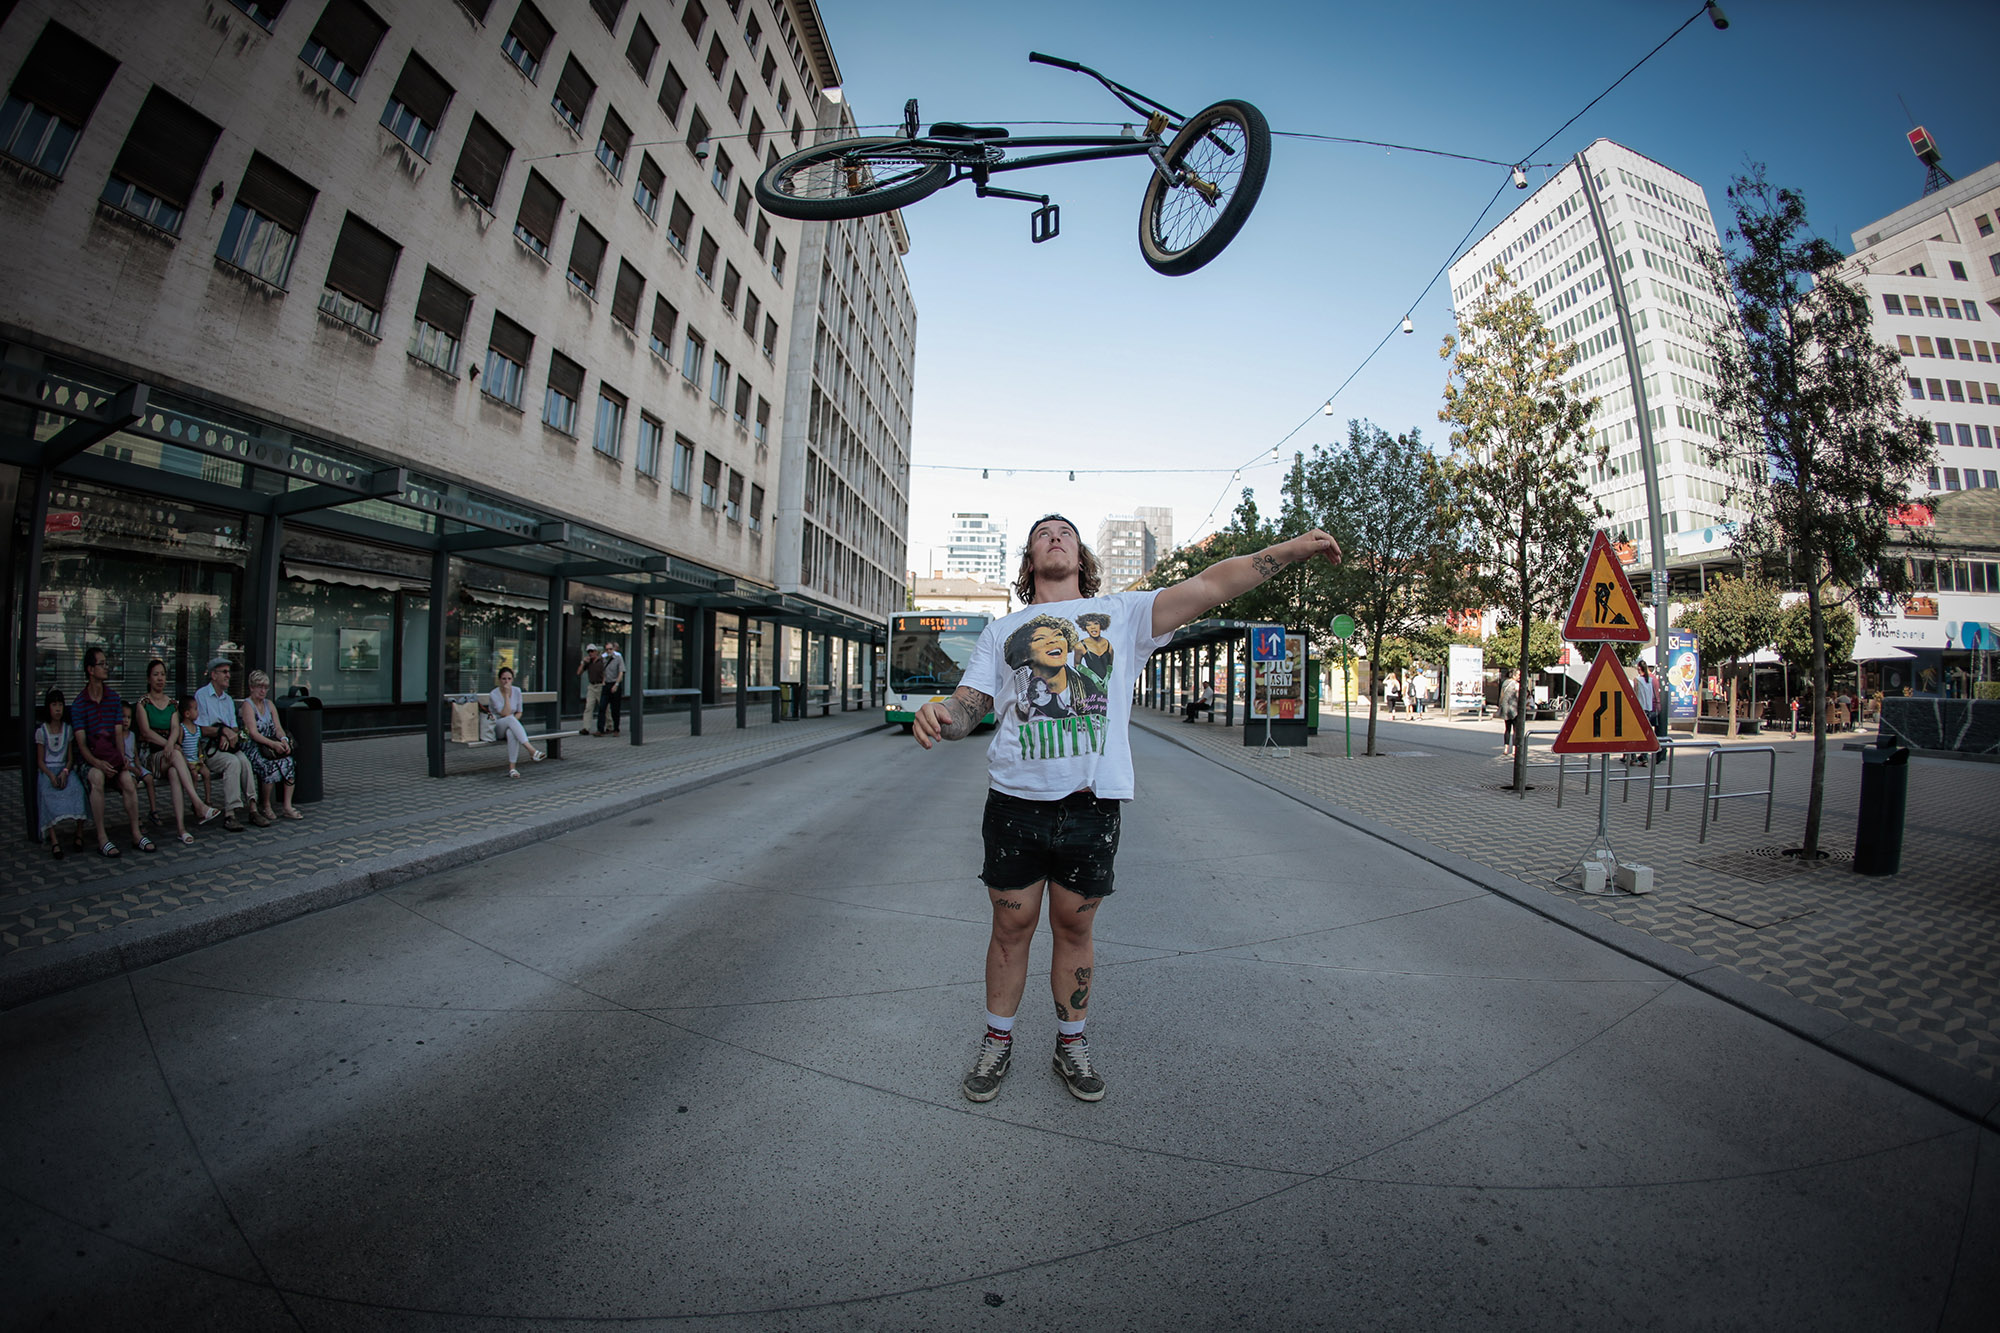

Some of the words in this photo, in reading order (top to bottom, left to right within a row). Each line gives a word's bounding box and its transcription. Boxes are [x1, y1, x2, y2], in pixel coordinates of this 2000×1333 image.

[899, 618, 906, 631] 1
[920, 618, 950, 626] MESTNI
[953, 618, 968, 626] LOG
